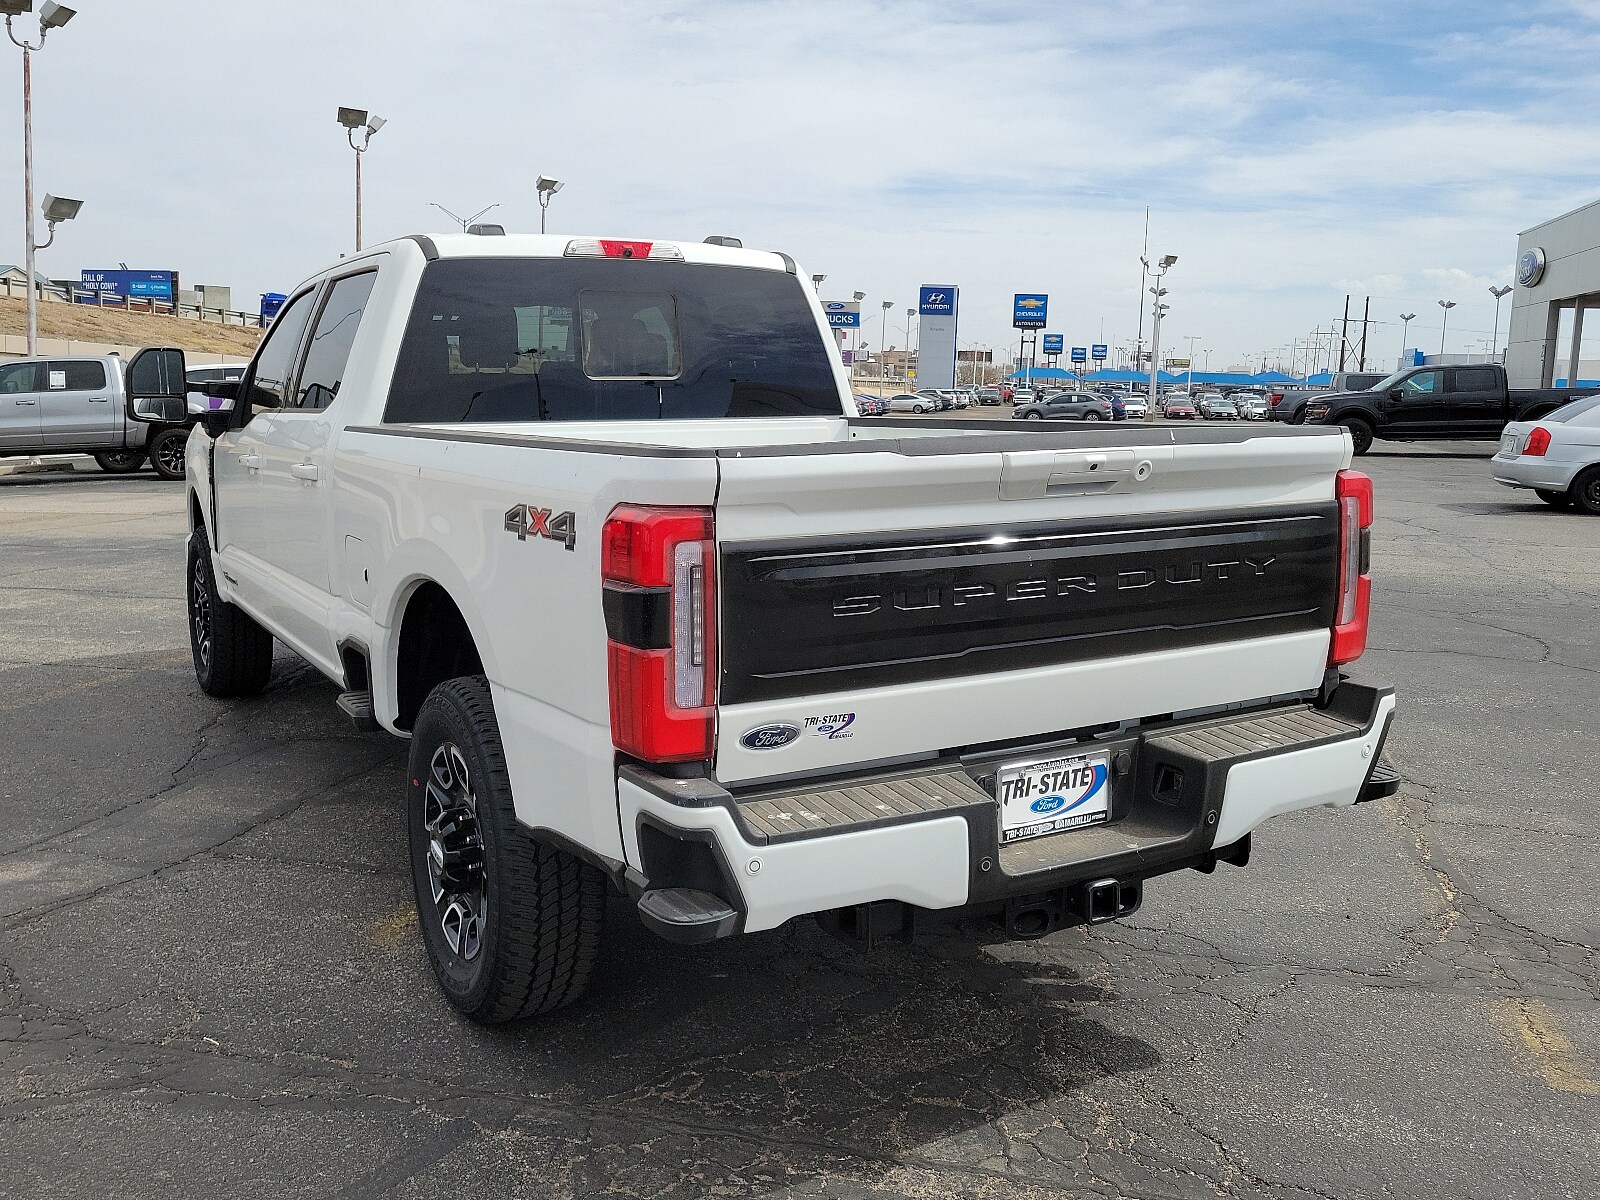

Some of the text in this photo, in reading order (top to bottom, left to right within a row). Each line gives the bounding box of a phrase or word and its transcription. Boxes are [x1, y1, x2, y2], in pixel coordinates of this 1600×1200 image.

[82, 273, 104, 282] FULL OF
[827, 314, 854, 324] UCKS
[832, 554, 1276, 617] SUPER DUTY
[804, 713, 849, 728] TRI-STATE
[755, 729, 789, 746] Ford
[1001, 766, 1091, 807] TRI-STATE
[1037, 797, 1059, 811] Ford
